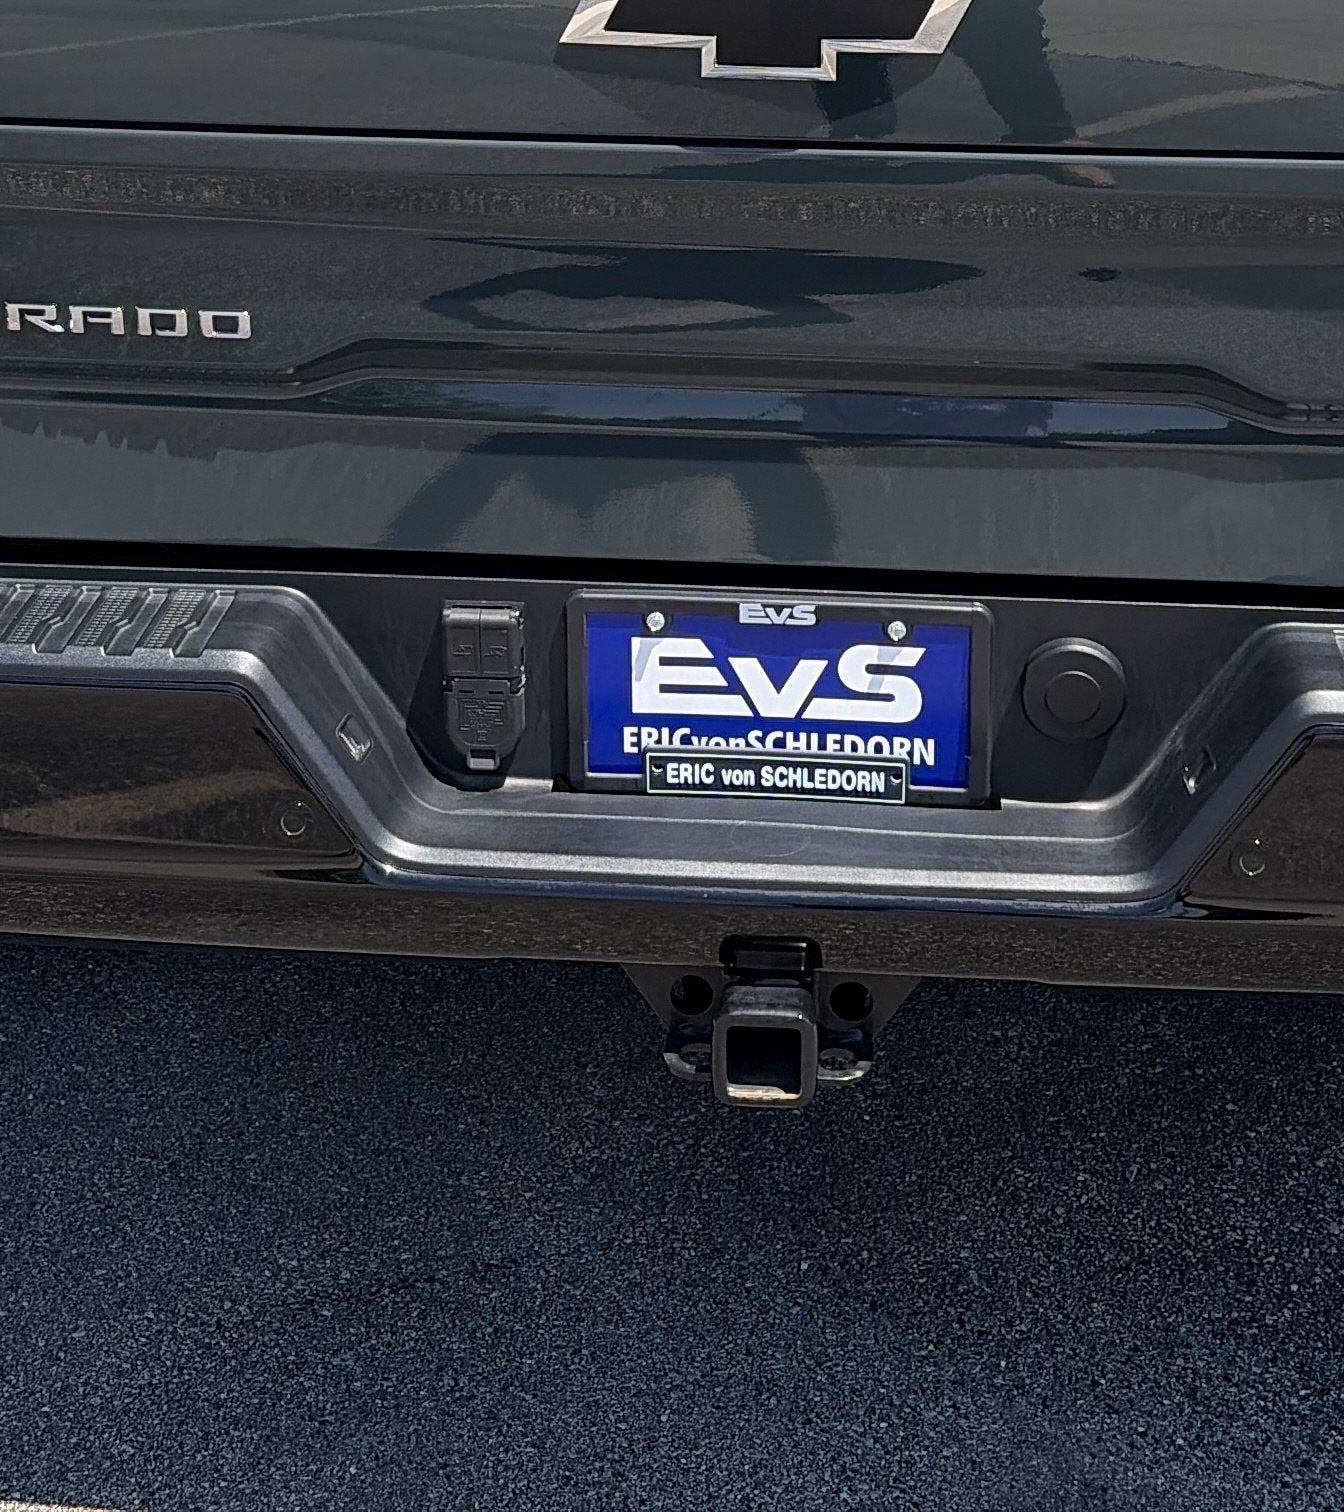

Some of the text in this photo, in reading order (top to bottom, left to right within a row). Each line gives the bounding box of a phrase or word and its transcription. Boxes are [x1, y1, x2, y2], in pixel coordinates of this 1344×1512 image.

[665, 761, 886, 793] ERIC von SCHLEDORN
